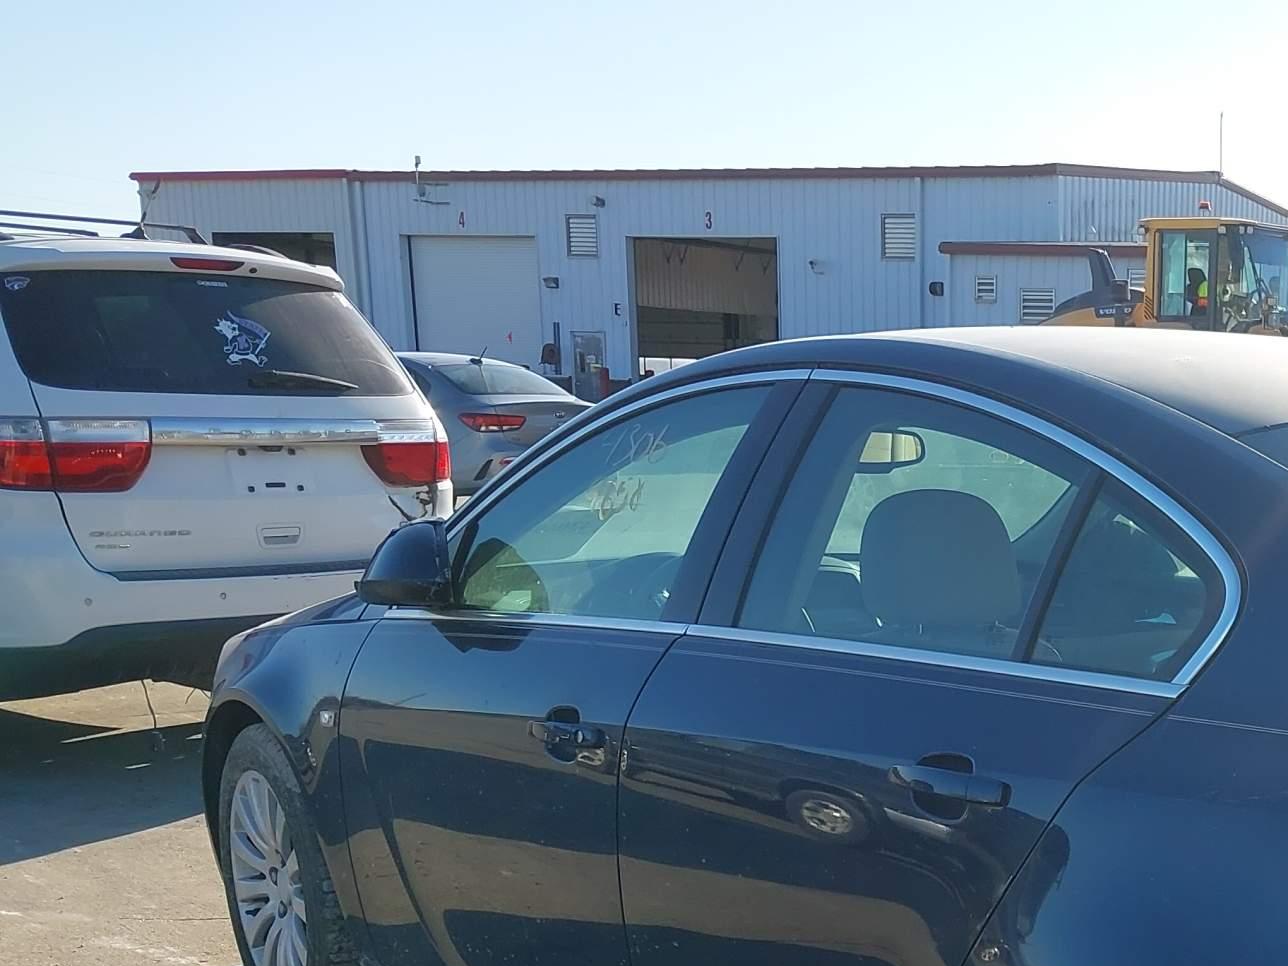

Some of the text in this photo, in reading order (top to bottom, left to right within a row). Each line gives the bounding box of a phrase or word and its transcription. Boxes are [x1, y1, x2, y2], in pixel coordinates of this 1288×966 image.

[458, 211, 465, 228] 4
[705, 211, 713, 230] 3
[614, 303, 621, 316] E
[1099, 307, 1132, 315] VOLO
